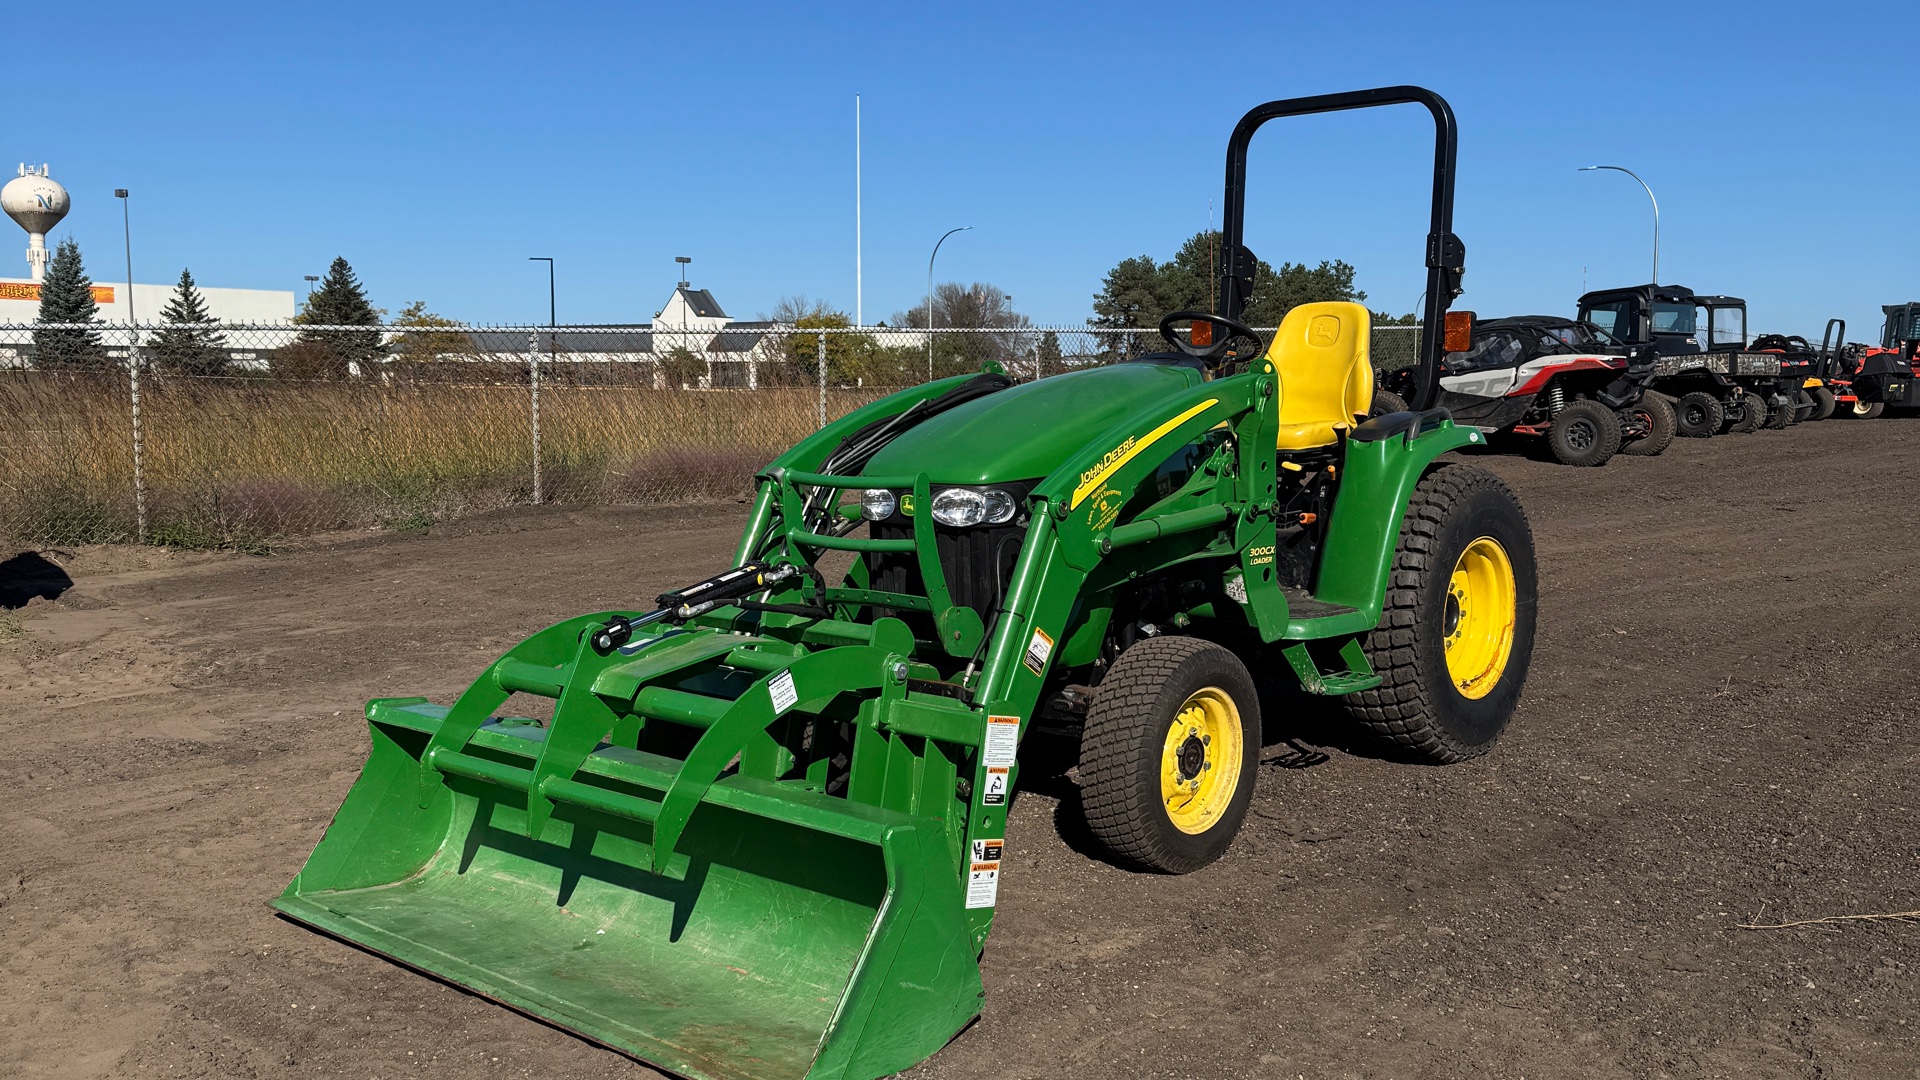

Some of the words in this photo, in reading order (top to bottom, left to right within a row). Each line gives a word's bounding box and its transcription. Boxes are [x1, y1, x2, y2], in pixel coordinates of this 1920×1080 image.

[1078, 459, 1104, 489] JOHN
[1103, 435, 1136, 469] DEERE
[1249, 545, 1276, 557] 300CX
[1250, 556, 1273, 566] LOADER
